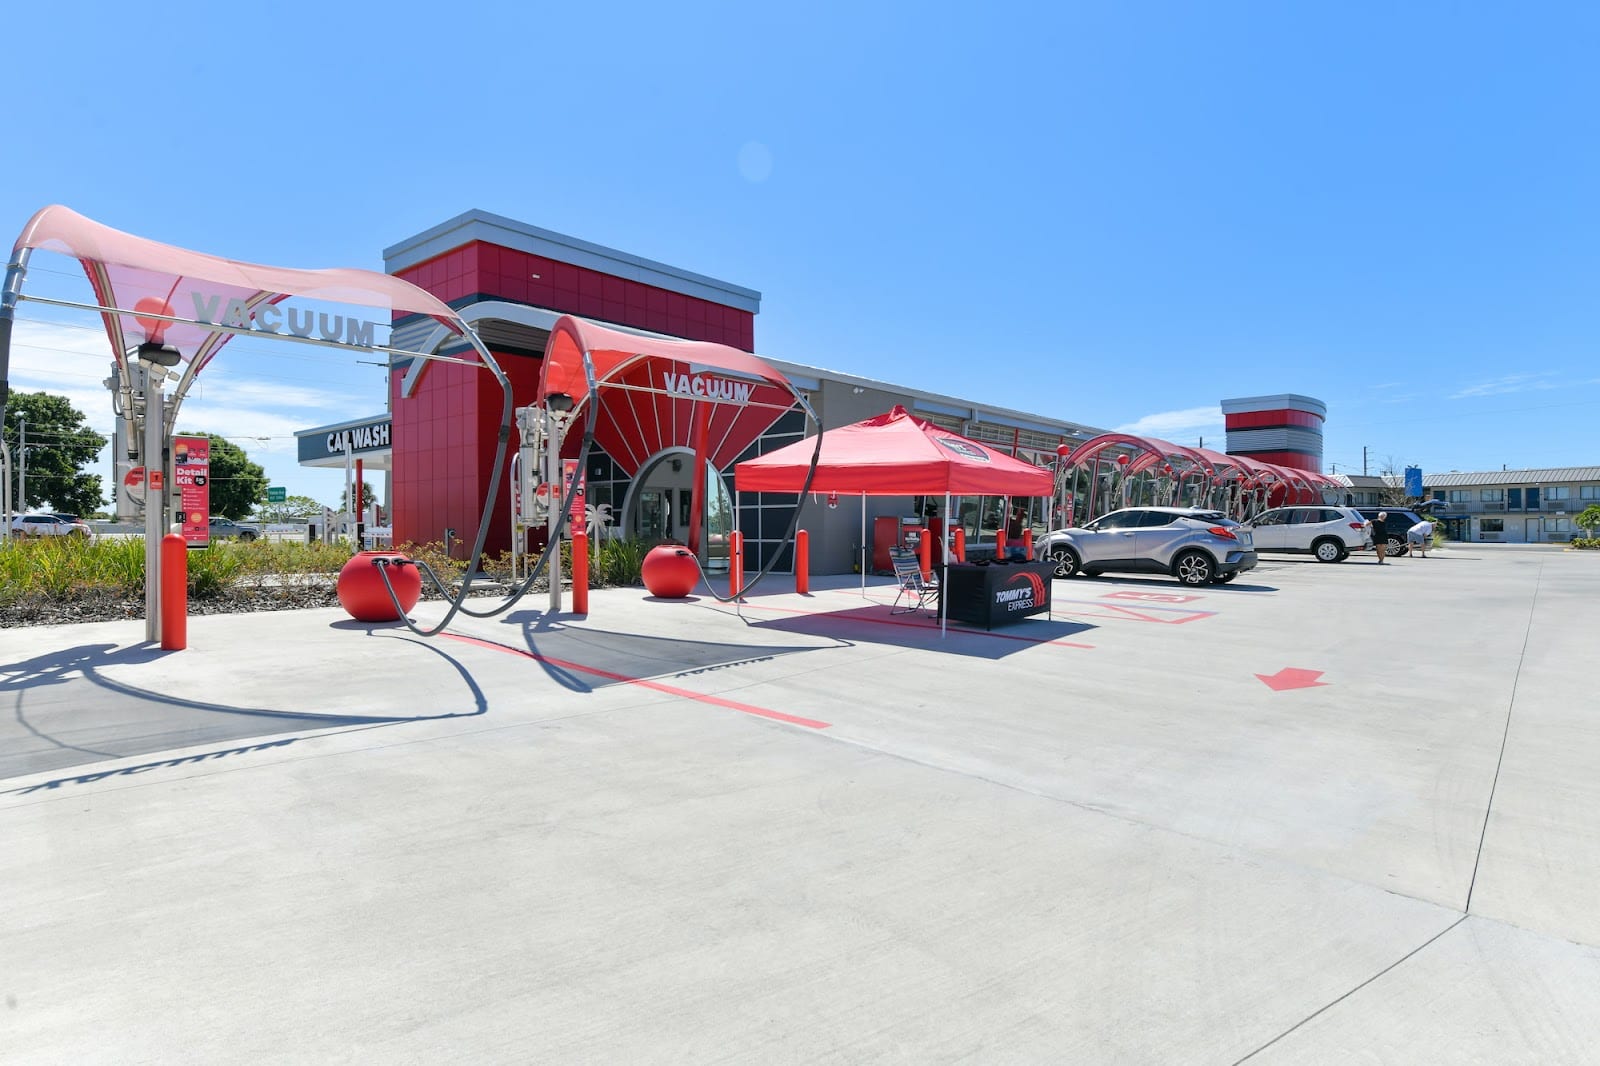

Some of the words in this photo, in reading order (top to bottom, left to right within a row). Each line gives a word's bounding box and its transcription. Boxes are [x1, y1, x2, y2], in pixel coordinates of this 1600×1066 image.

[191, 292, 374, 347] VACUUM
[663, 372, 749, 404] VACUUM
[352, 424, 389, 449] WASH
[176, 467, 207, 477] Detail
[176, 476, 193, 485] Kit
[996, 587, 1032, 603] TOMMY'S
[1007, 598, 1034, 611] EXPRESS
